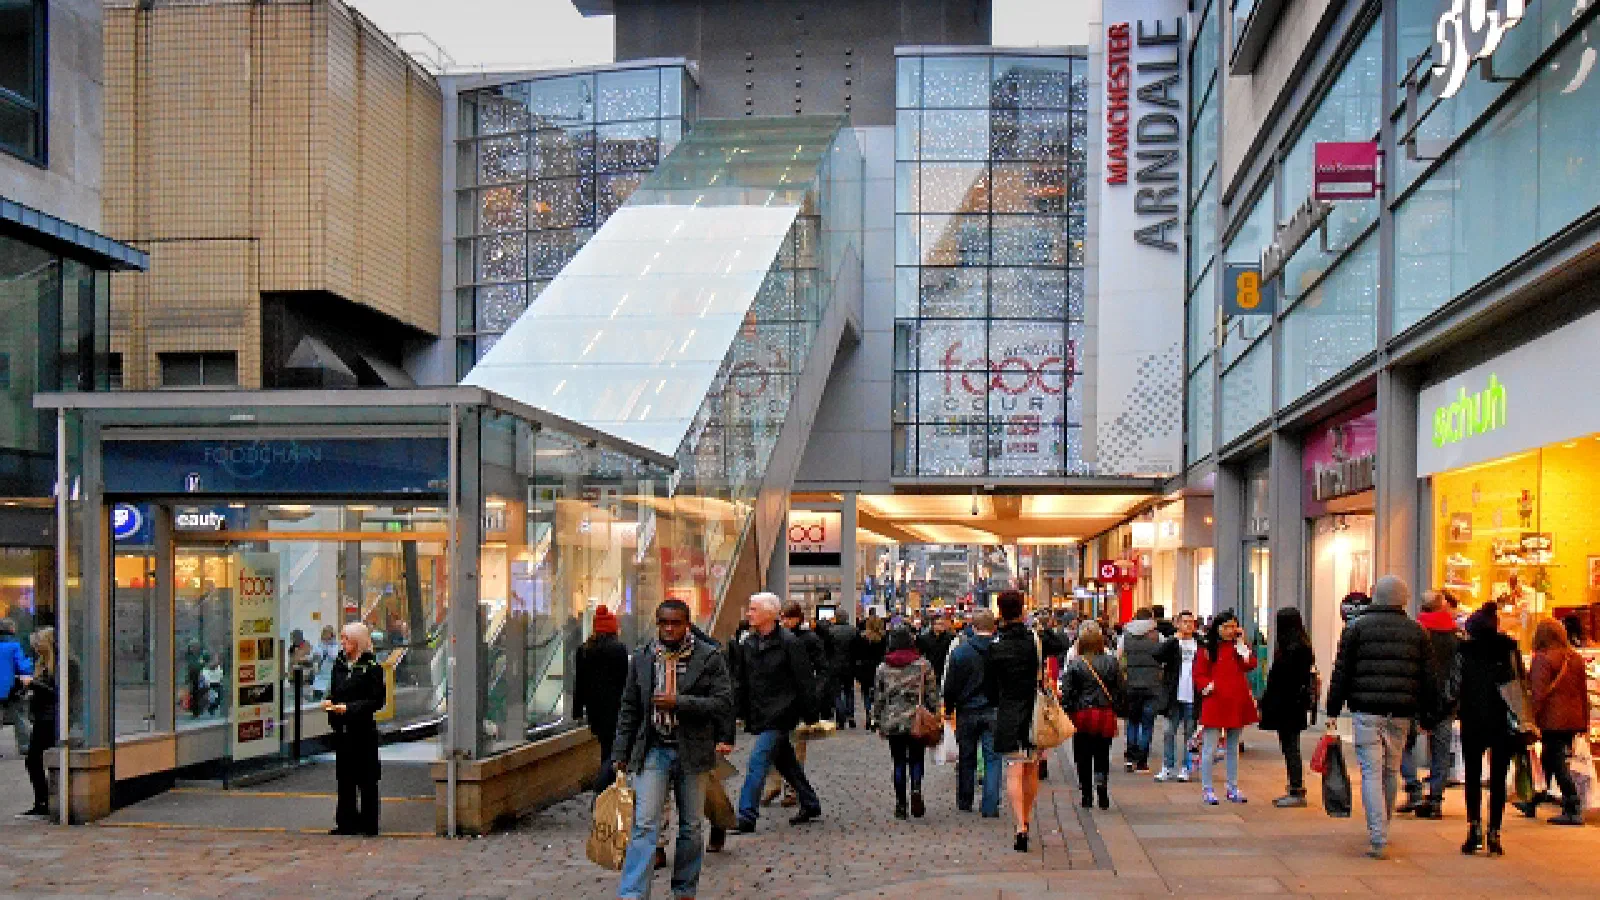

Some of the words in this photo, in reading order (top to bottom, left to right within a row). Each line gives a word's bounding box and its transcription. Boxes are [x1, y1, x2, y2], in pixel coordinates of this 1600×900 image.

[1106, 21, 1130, 186] MANCHESTER
[1133, 17, 1182, 252] ARNDALE
[939, 340, 1076, 395] food
[943, 397, 1072, 411] COURT
[1432, 372, 1506, 448] schuh
